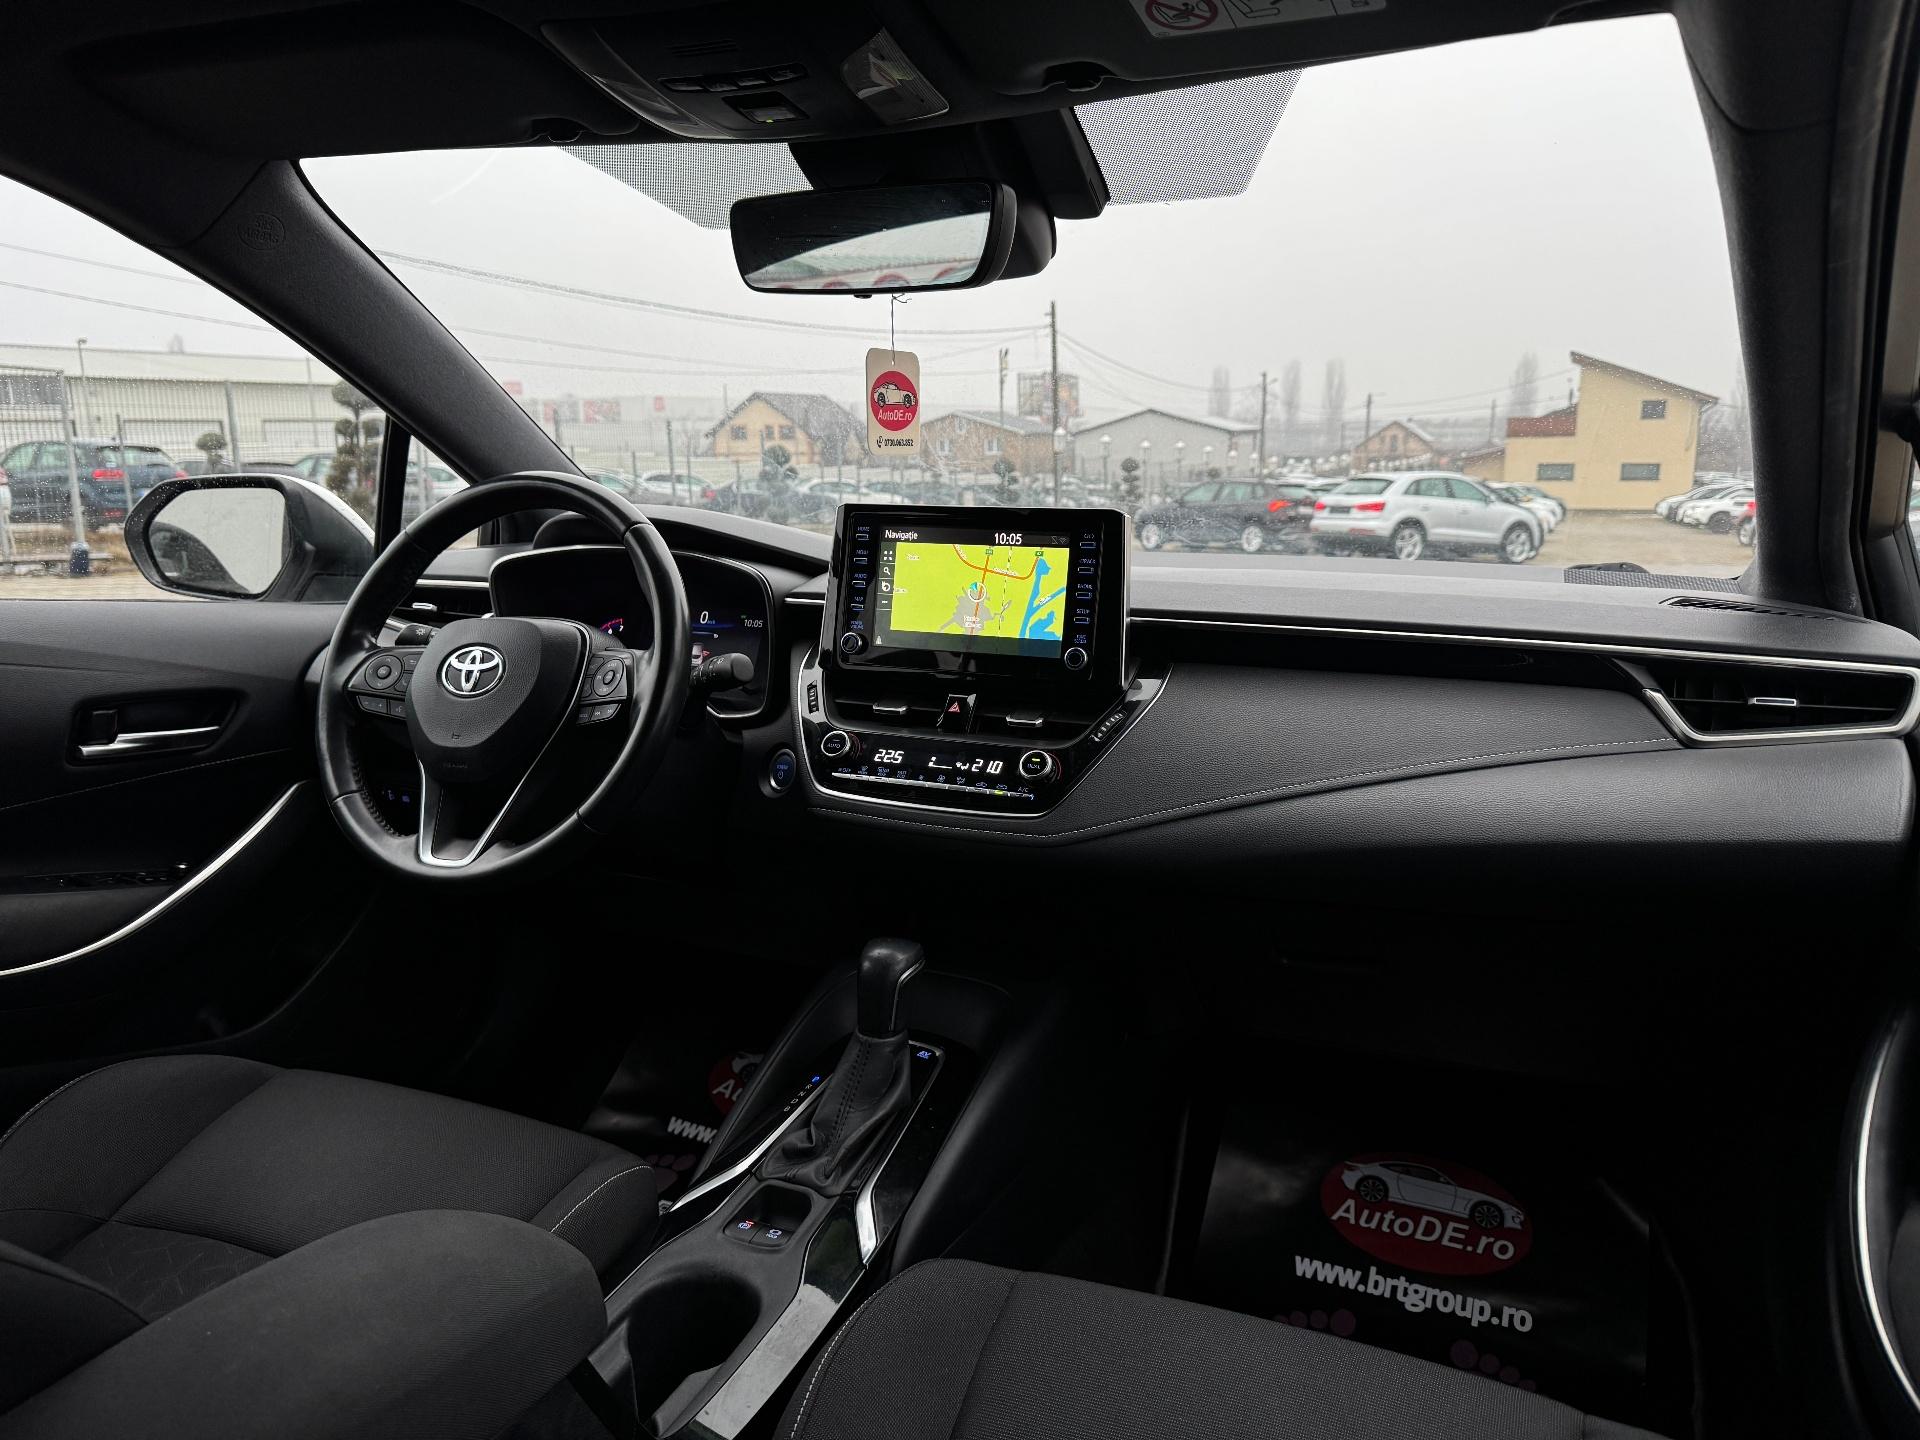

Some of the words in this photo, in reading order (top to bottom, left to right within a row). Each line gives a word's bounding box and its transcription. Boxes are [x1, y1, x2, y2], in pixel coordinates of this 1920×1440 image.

[877, 409, 913, 421] AutoDE.ro
[994, 532, 1023, 545] 10:05
[699, 610, 709, 624] 0
[743, 619, 764, 628] 10:05
[1330, 1197, 1516, 1262] AutoDE.ro
[1293, 1254, 1533, 1333] www.brtgroup.ro
